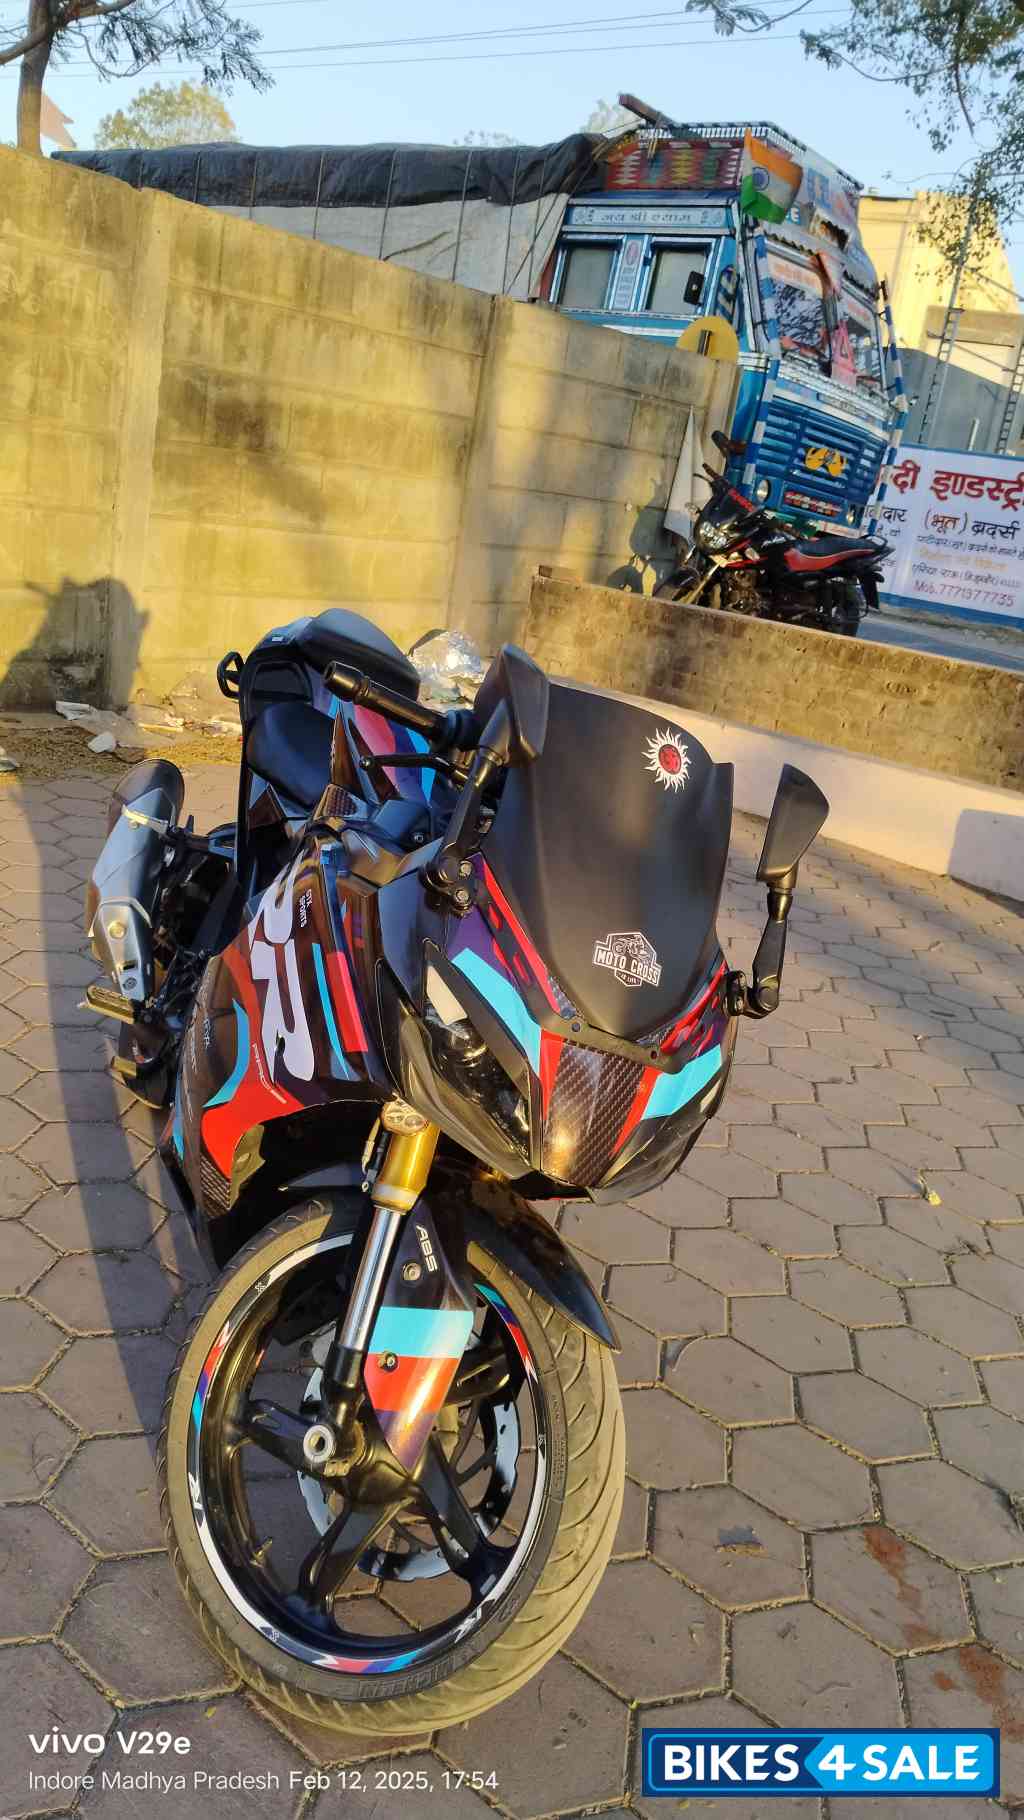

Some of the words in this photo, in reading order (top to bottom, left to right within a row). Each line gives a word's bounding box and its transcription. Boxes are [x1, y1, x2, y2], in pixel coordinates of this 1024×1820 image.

[597, 949, 627, 970] MOTO
[630, 959, 659, 983] CROSS
[415, 1225, 438, 1273] ABS
